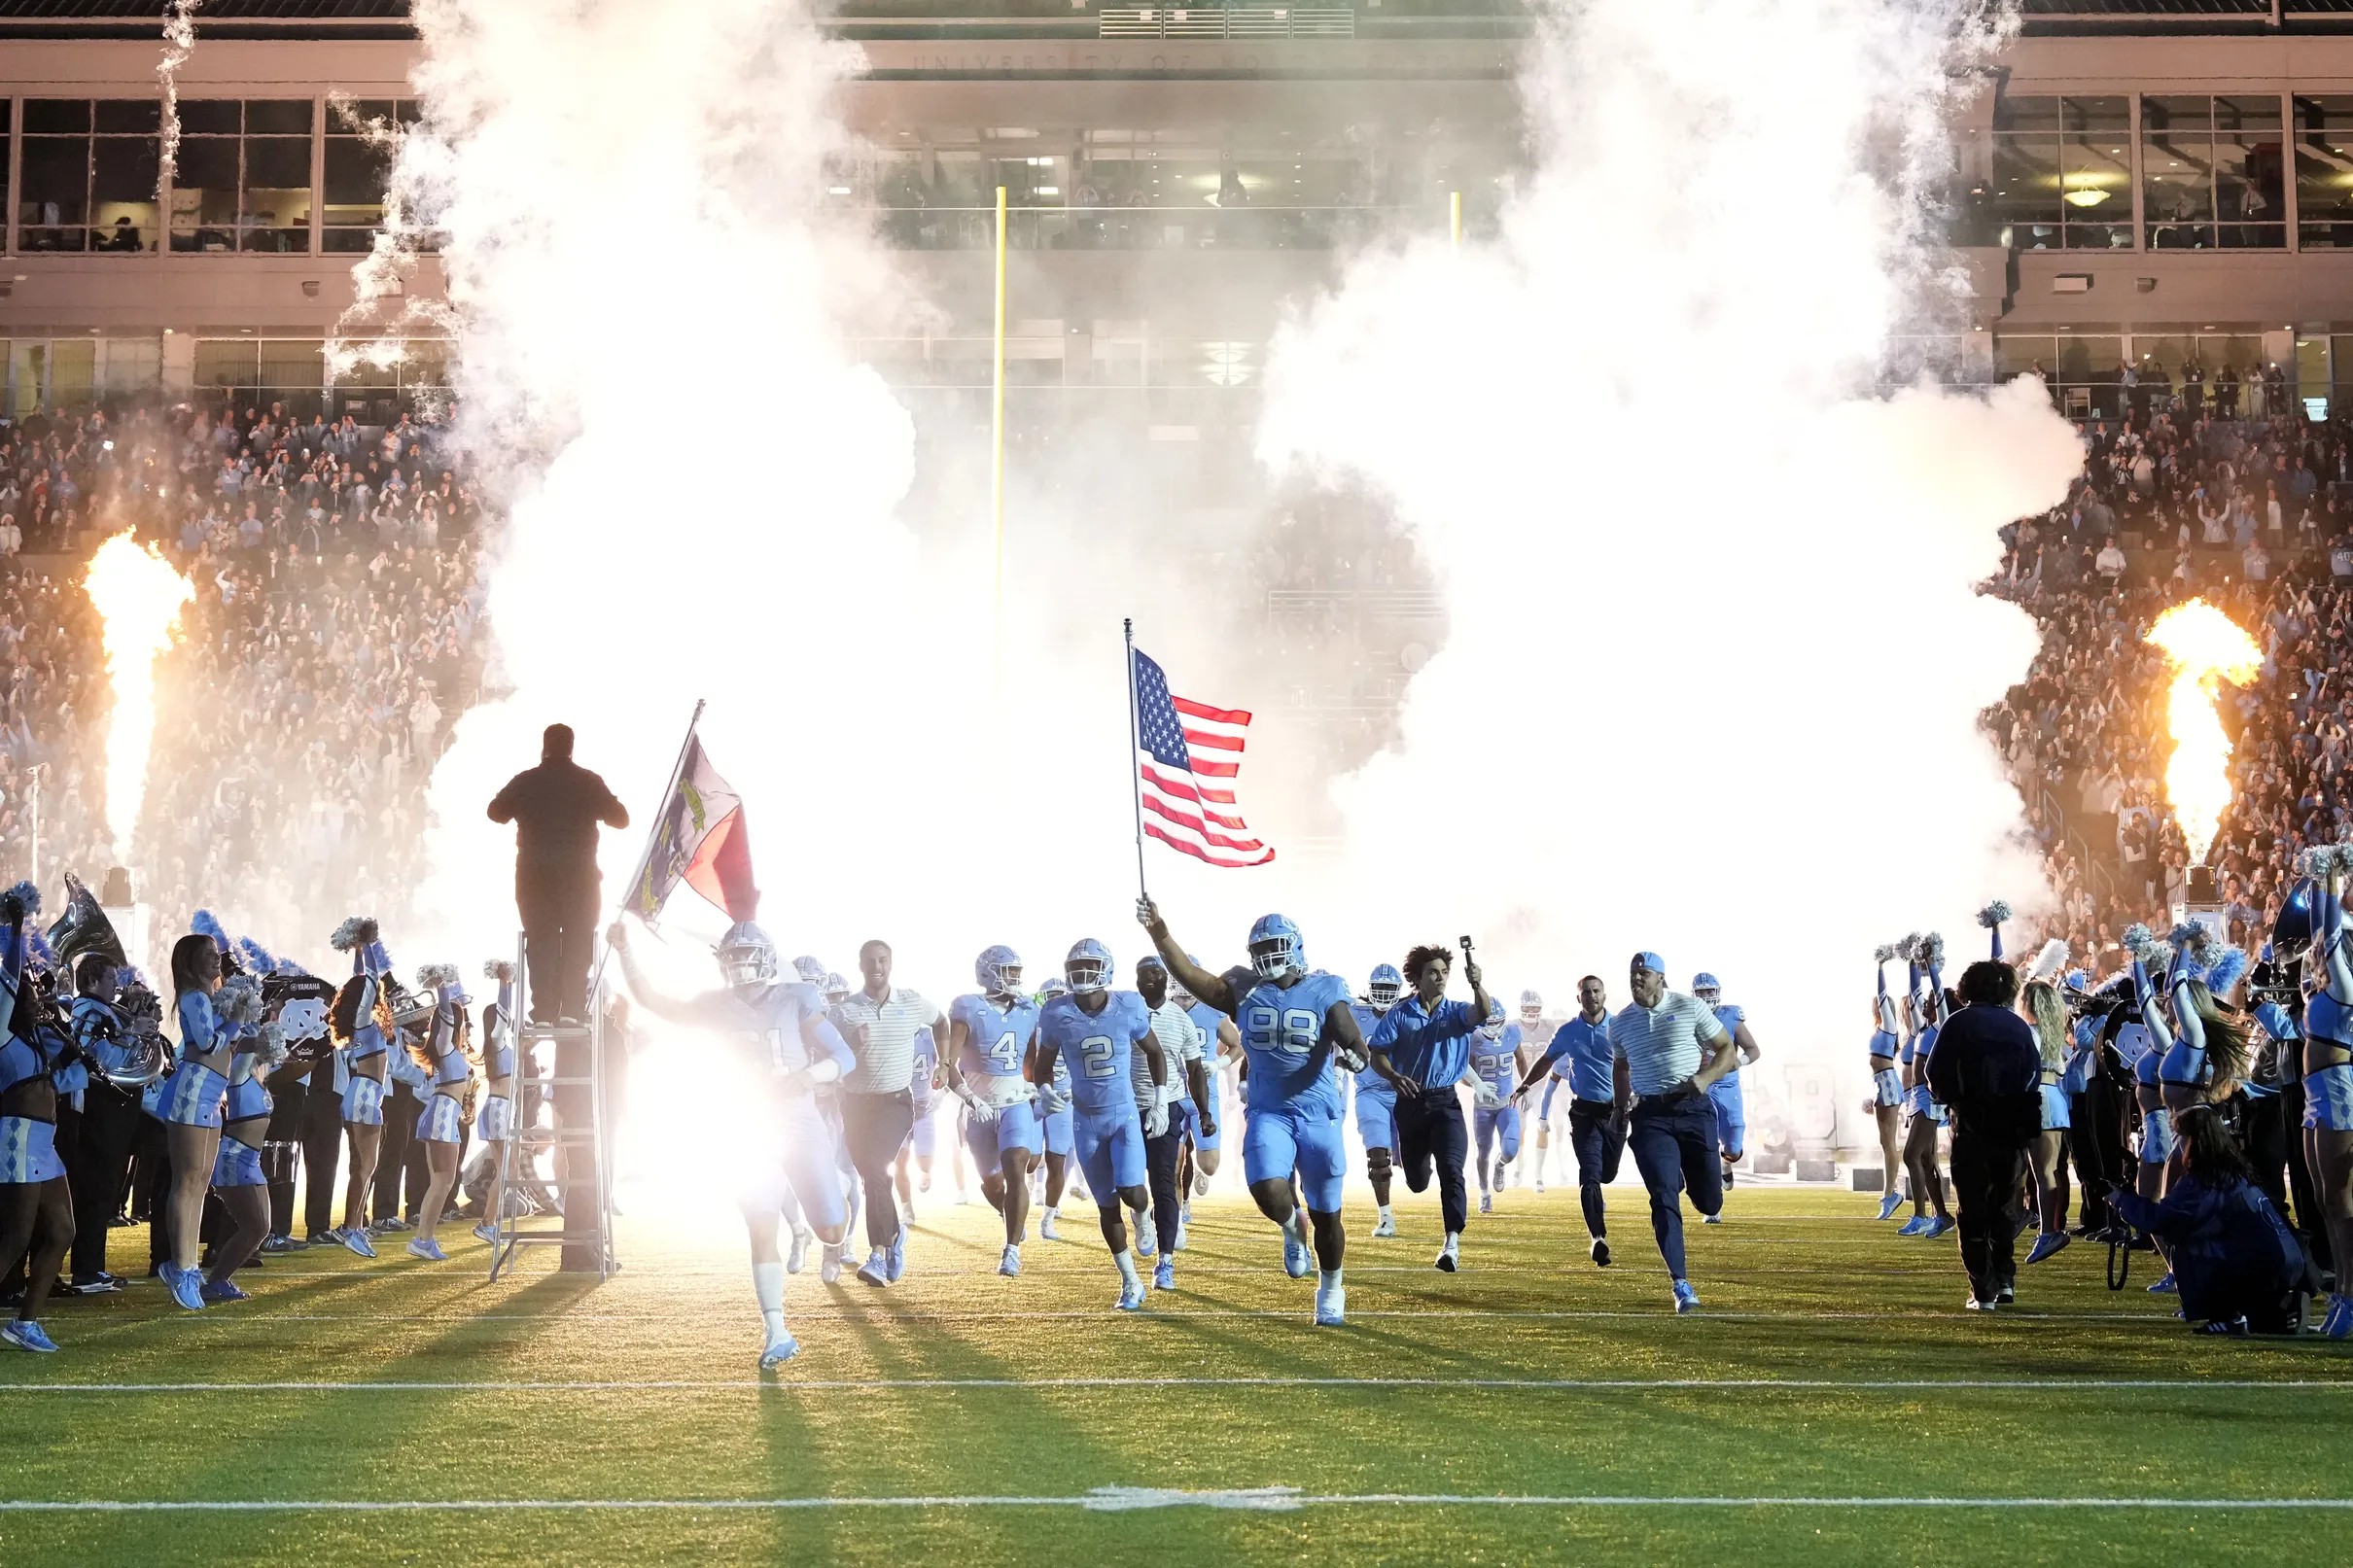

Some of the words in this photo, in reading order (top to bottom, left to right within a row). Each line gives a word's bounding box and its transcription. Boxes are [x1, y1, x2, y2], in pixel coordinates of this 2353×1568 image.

[990, 1030, 1018, 1071] 4
[1247, 1006, 1319, 1053] 98
[1079, 1034, 1117, 1079] 2
[1477, 1050, 1515, 1078] 25
